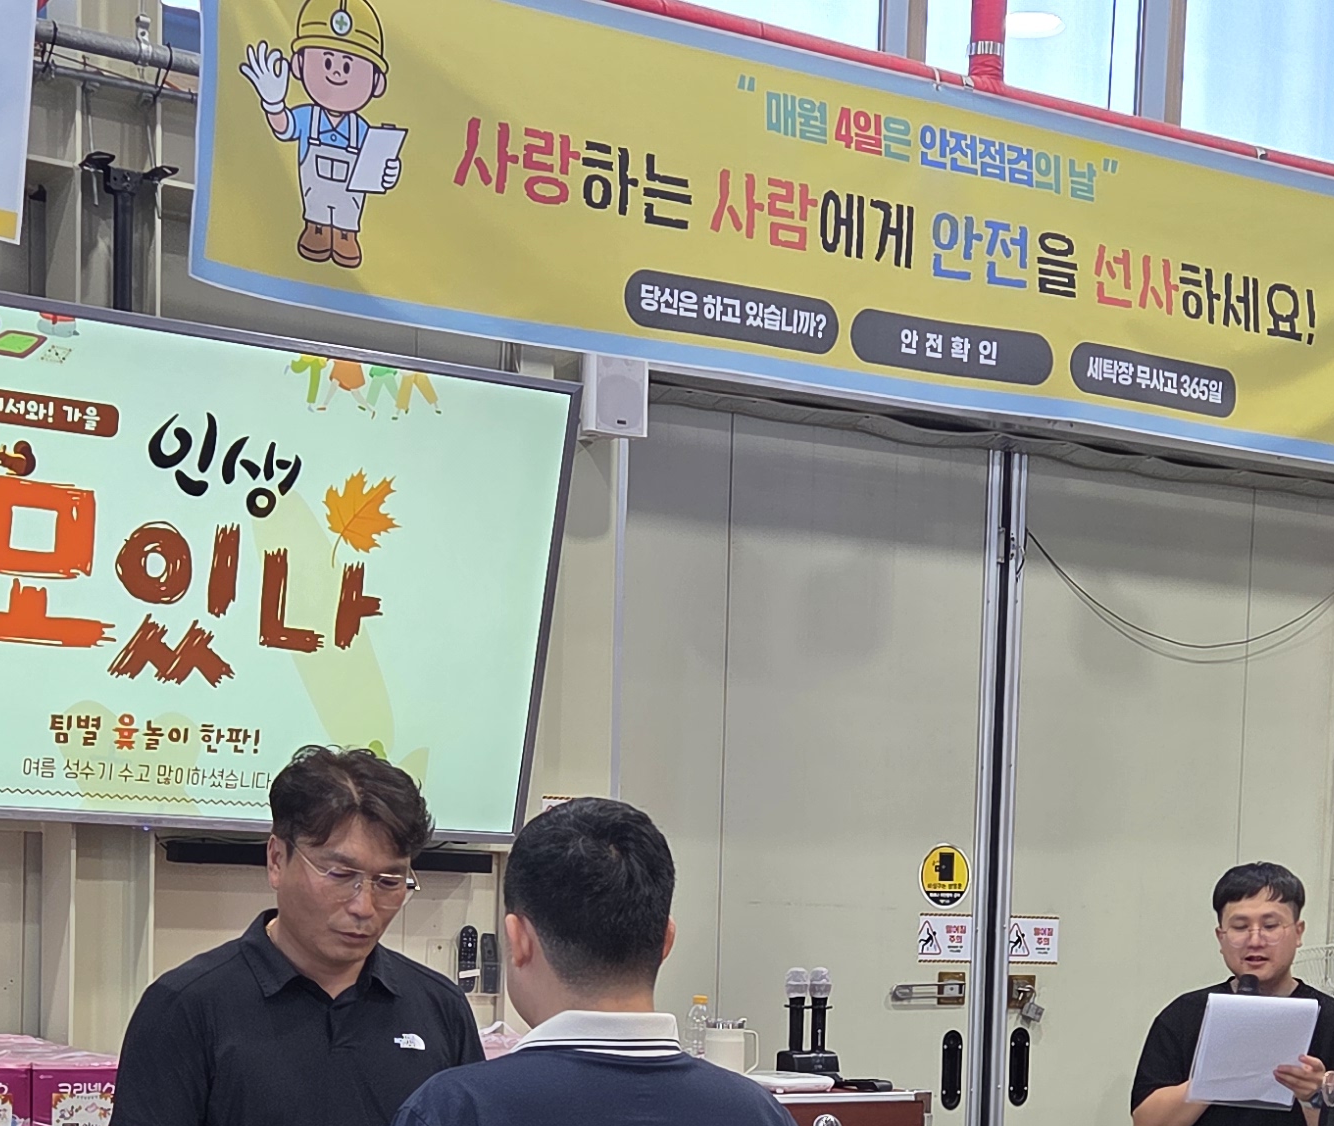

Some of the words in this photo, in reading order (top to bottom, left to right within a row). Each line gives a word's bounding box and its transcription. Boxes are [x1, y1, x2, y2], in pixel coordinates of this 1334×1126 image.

[835, 107, 911, 162] 4일은
[919, 124, 1061, 194] 안전점검의
[453, 117, 693, 229] 사랑하는
[709, 169, 915, 268] 사람에게
[931, 212, 1078, 298] 안전을
[1094, 244, 1317, 344] 선사하세요!
[640, 284, 698, 318] 당신은
[702, 295, 741, 324] 하고
[744, 300, 827, 339] 있습니까?
[1086, 356, 1135, 386] 세탁장
[1136, 364, 1179, 396] 무사고
[1180, 370, 1222, 403] 365일
[62, 405, 101, 431] 가을
[148, 411, 302, 518] 인생
[49, 714, 101, 746] 팀별
[112, 713, 189, 751] 윷놀이
[199, 724, 261, 754] 한판!
[22, 757, 56, 779] 여름
[63, 758, 113, 781] 성수기
[118, 763, 150, 783] 수고
